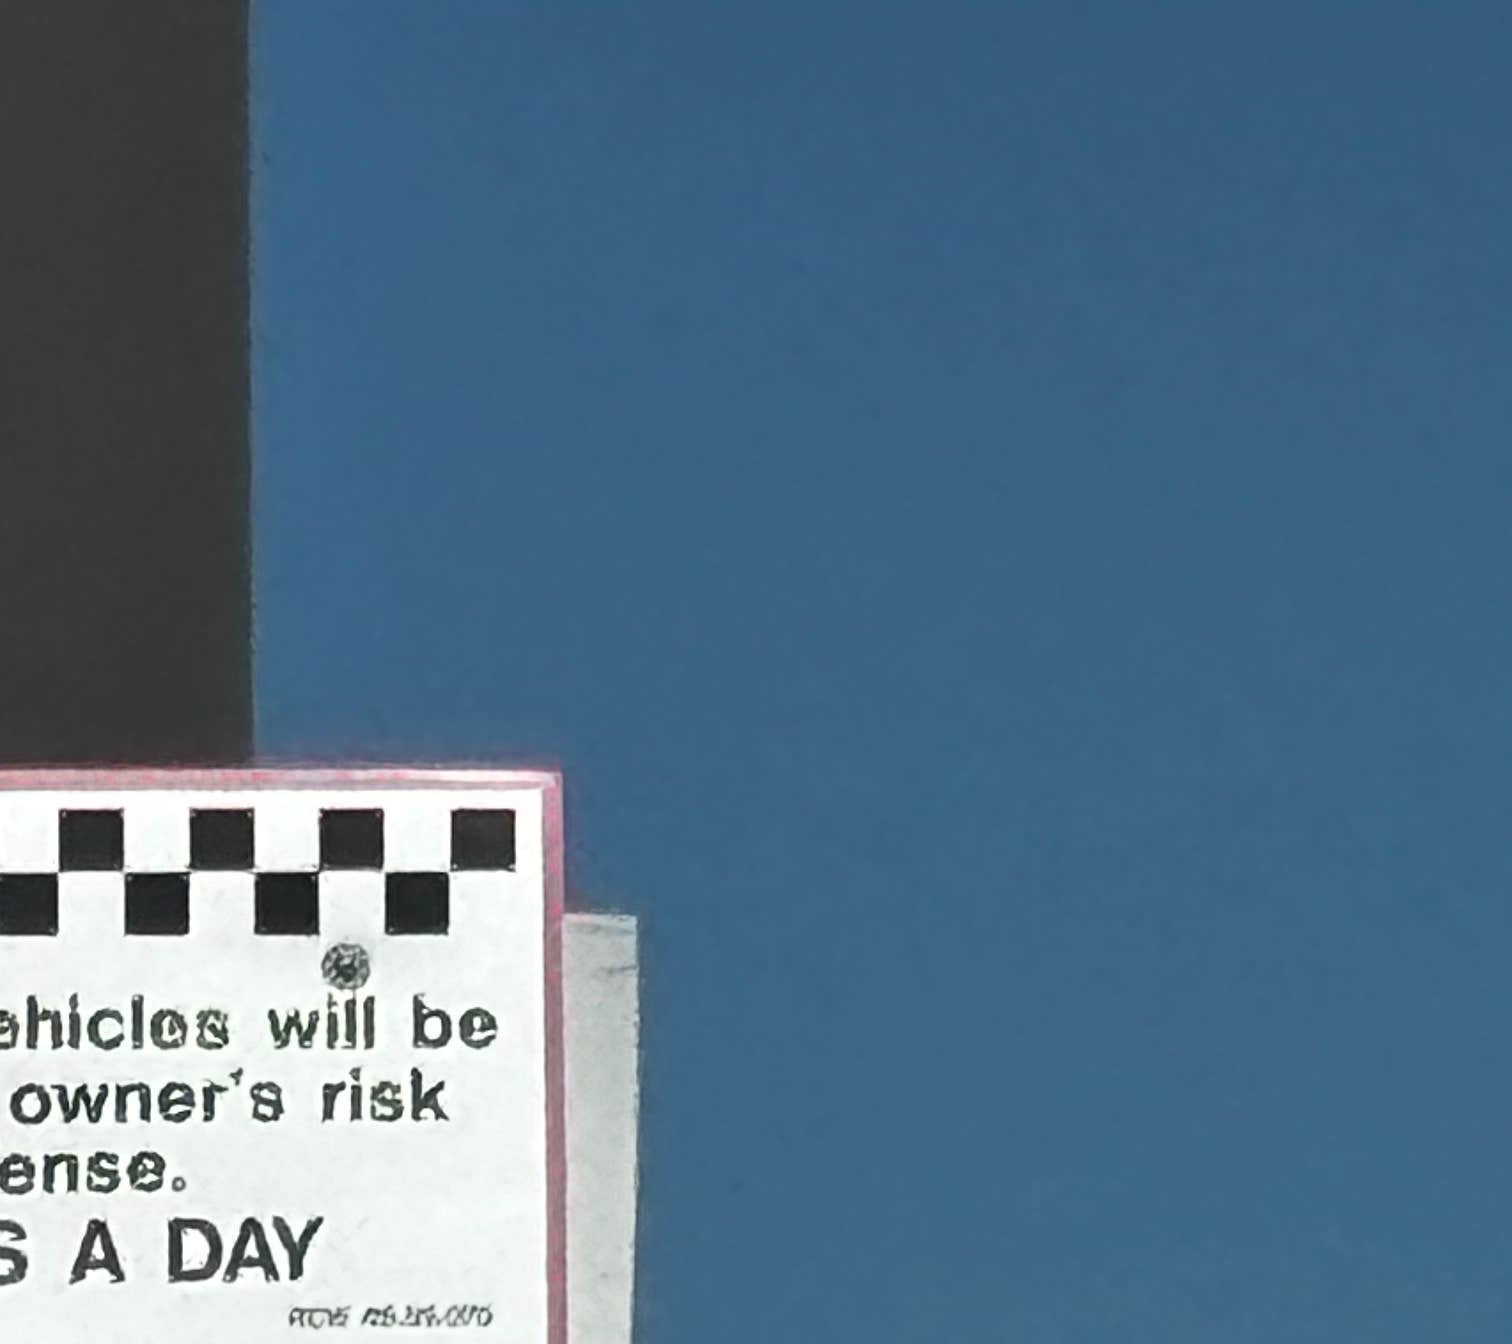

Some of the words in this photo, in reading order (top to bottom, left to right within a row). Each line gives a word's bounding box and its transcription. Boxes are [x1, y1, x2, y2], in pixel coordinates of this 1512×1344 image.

[268, 996, 375, 1050] will
[413, 995, 498, 1050] be
[9, 1068, 285, 1125] owner's
[322, 1068, 449, 1123] risk
[68, 1218, 126, 1285] A
[167, 1216, 324, 1284] DAY
